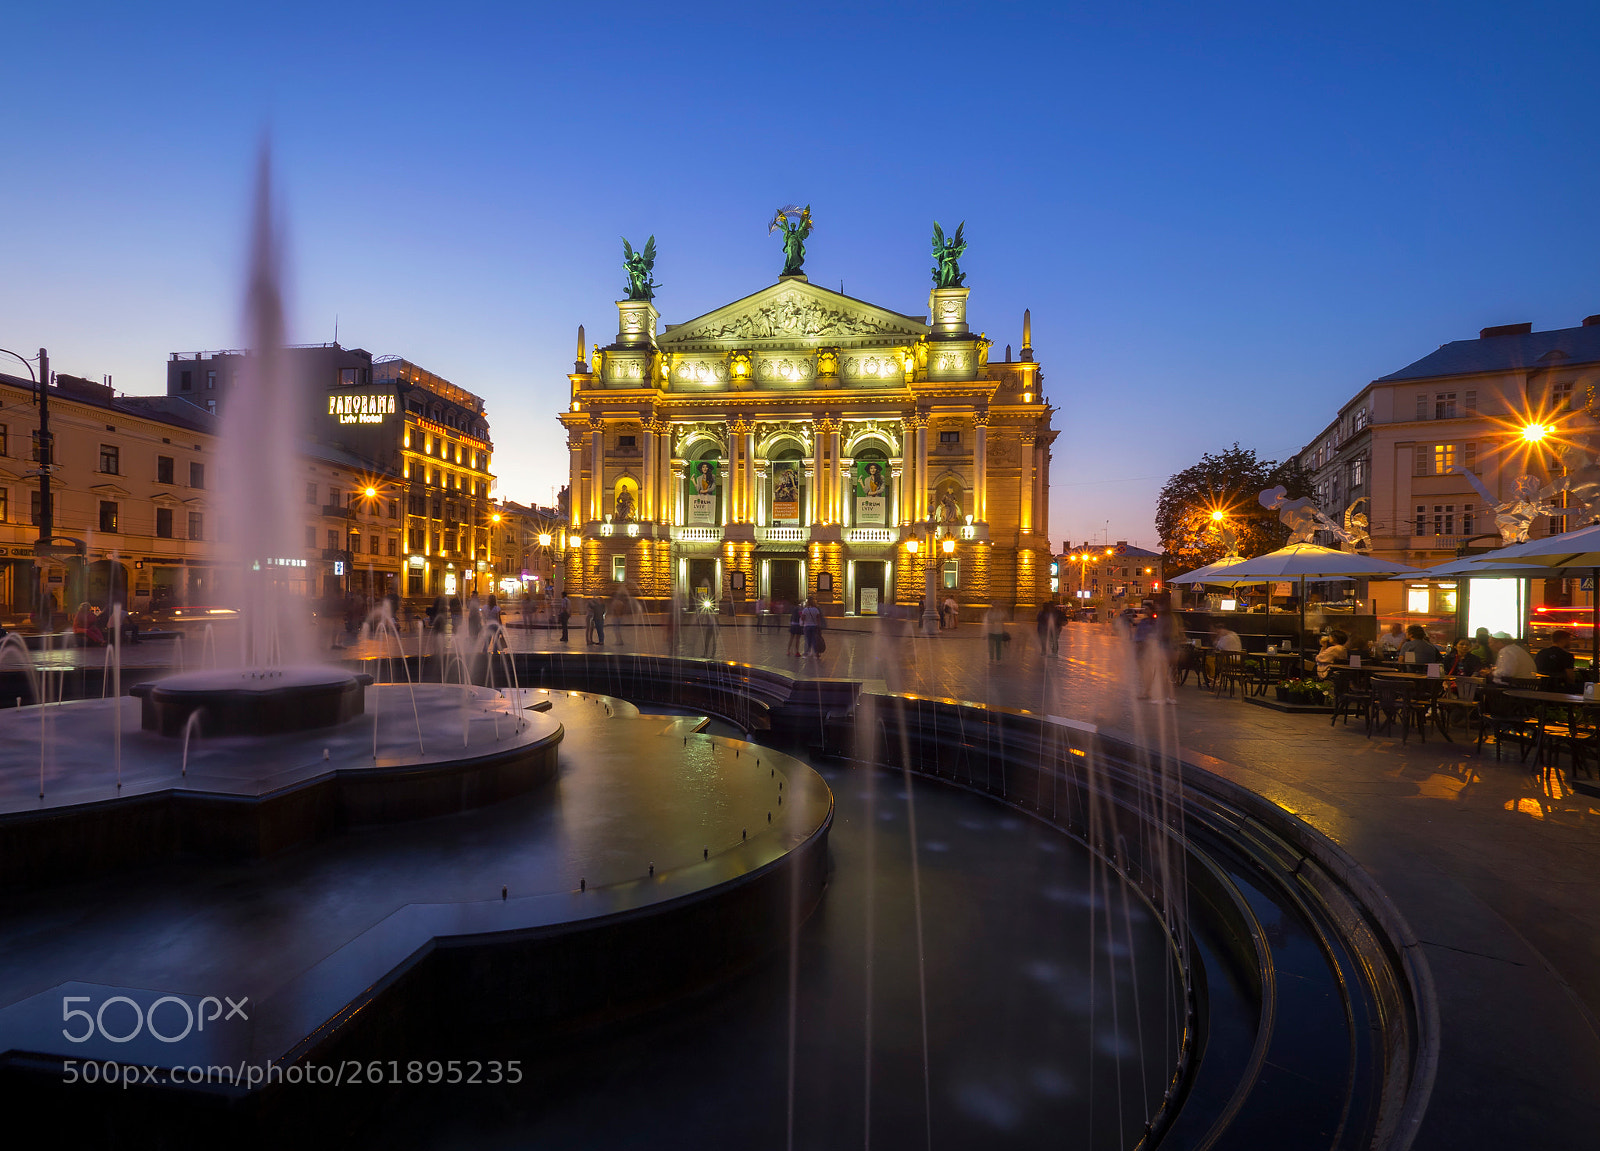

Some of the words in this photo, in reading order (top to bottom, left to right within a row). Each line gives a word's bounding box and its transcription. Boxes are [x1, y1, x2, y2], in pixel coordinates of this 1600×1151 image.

[328, 395, 396, 414] PANORAMA
[340, 414, 358, 424] Lviv
[359, 413, 383, 424] Hotel
